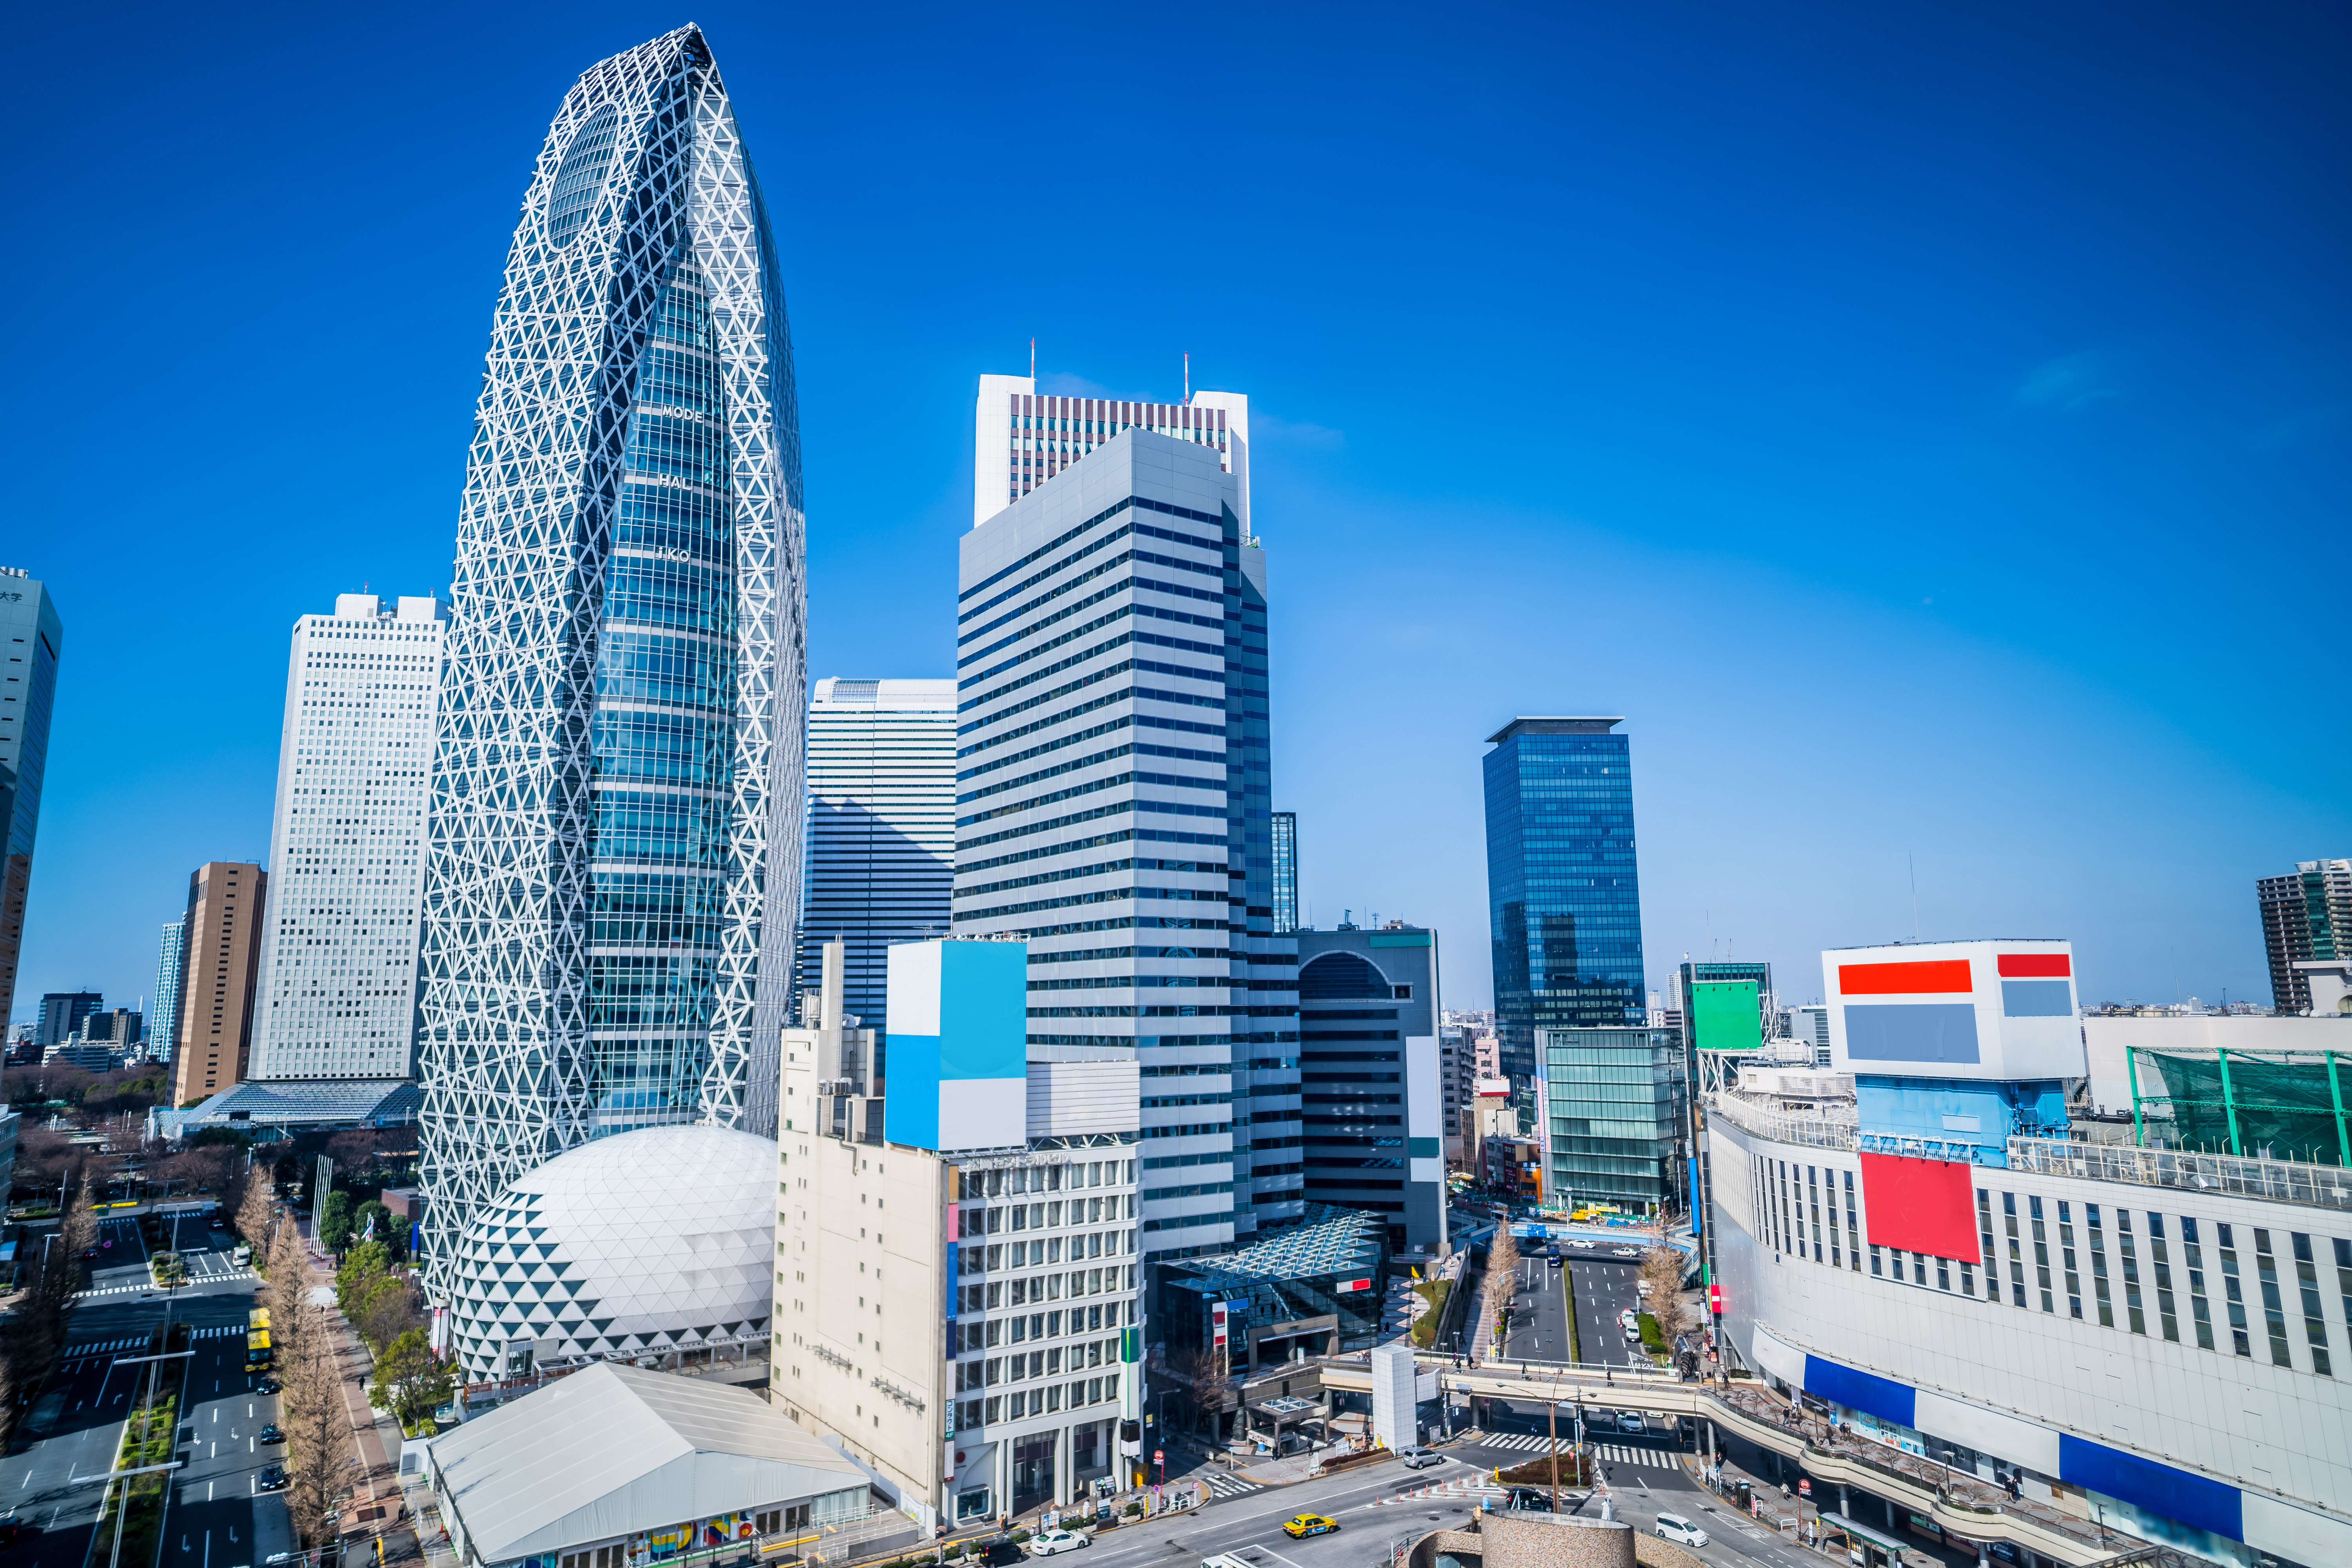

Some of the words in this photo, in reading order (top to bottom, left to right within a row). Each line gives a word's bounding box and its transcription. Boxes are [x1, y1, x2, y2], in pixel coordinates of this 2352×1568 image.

[662, 405, 702, 423] MODE
[659, 474, 691, 491] HAL
[0, 591, 22, 602] 大学
[966, 1152, 1069, 1171] 松岡セントラルビル
